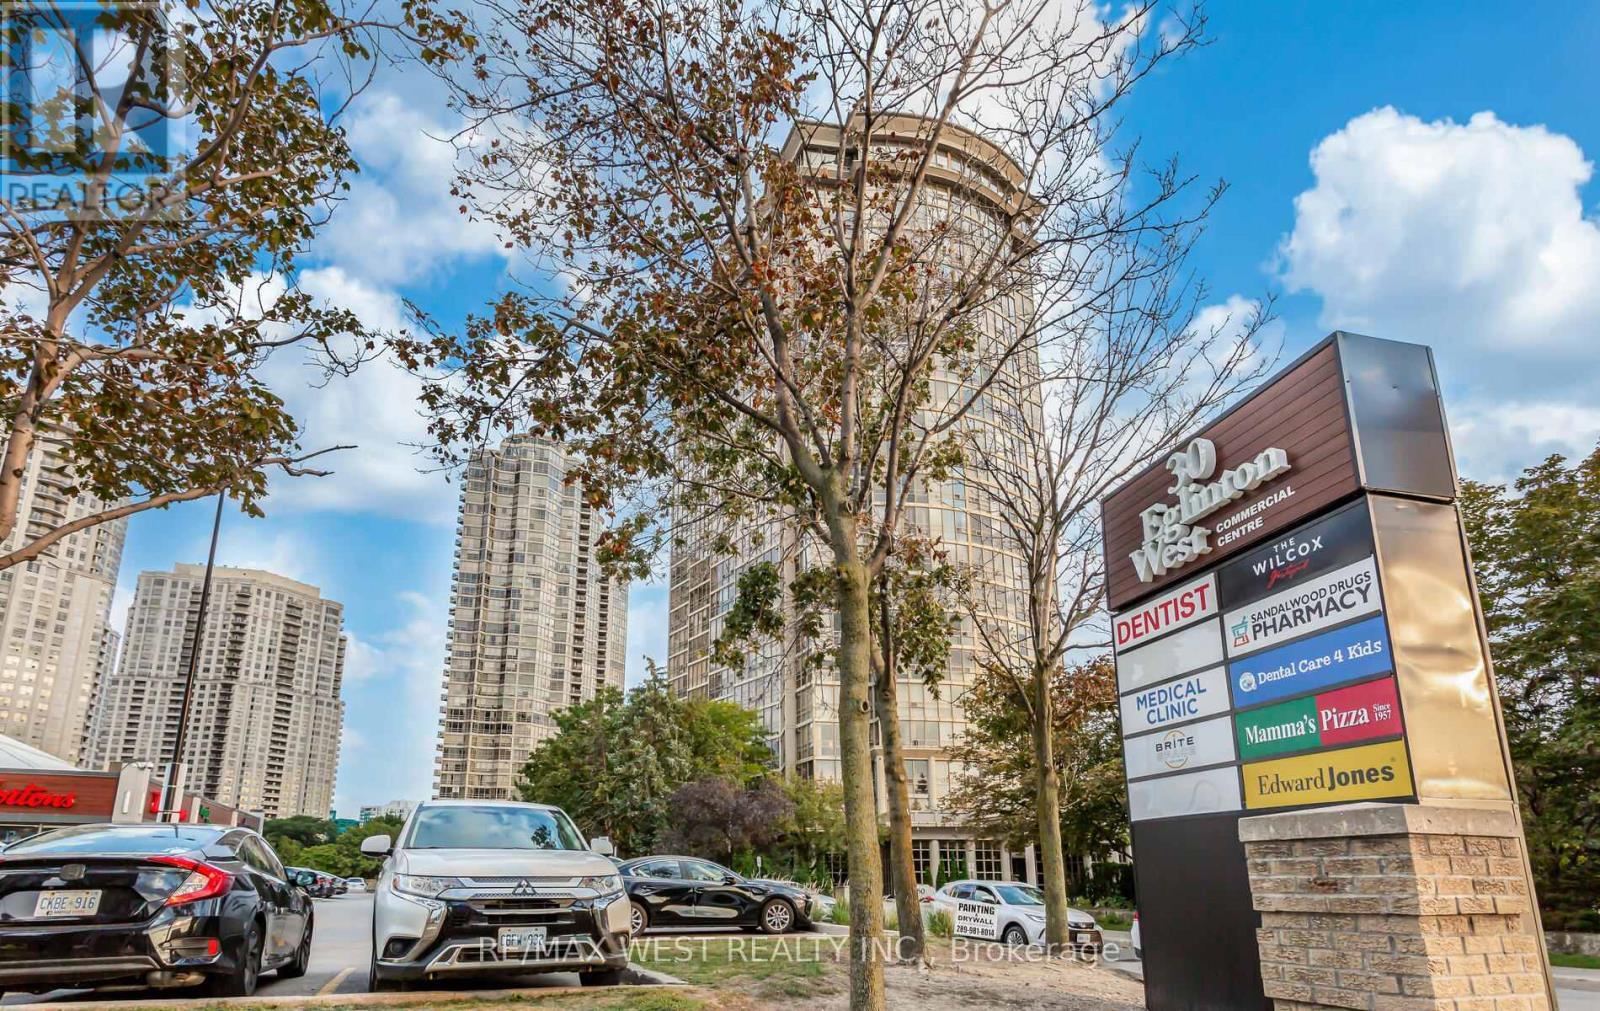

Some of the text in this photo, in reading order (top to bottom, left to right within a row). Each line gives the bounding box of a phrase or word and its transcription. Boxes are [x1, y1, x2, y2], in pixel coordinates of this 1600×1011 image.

[1165, 437, 1217, 495] 30
[1139, 447, 1292, 545] Eglinton
[1215, 485, 1296, 534] COMMERCIAL
[1217, 516, 1265, 547] CENTRE
[1273, 537, 1296, 553] THE
[1128, 525, 1213, 583] West
[1252, 535, 1324, 576] WILCOX
[1117, 583, 1210, 645] DENTIST
[1251, 587, 1327, 624] SANDALWOOD
[1329, 571, 1371, 594] DRUGS
[1252, 582, 1372, 641] PHARMACY
[1258, 640, 1382, 685] Dental Care 4 Kids
[1137, 678, 1207, 711] MEDICAL
[1146, 698, 1199, 725] CLINIC
[1372, 703, 1391, 713] Since
[1245, 707, 1370, 746] Mamma's Pizza
[1374, 710, 1392, 722] 1957
[1156, 736, 1195, 752] BRITE
[1258, 765, 1395, 796] Edward Jones
[958, 902, 995, 915] PAINTING
[958, 915, 994, 925] DRYWALL
